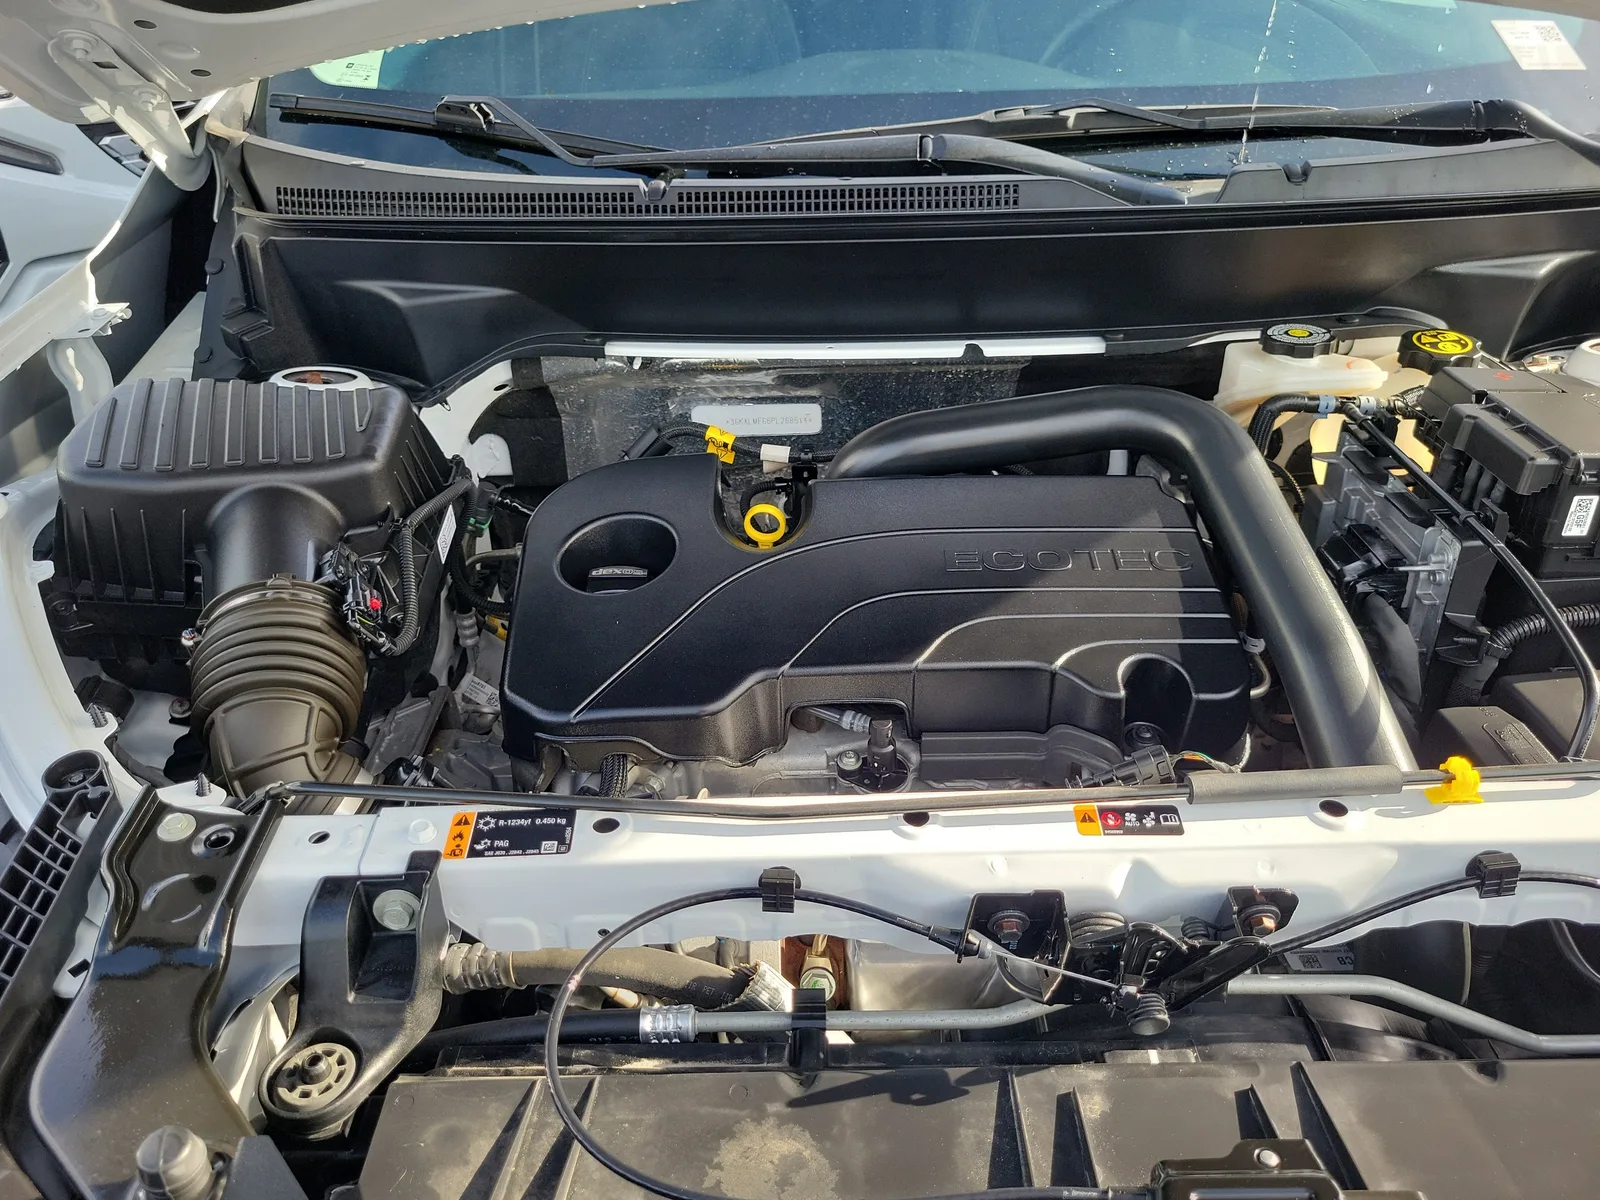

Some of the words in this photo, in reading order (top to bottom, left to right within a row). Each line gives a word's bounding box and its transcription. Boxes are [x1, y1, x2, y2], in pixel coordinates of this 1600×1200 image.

[944, 549, 1194, 572] ECOTEC
[498, 818, 531, 827] R-1234yf
[556, 817, 567, 825] kg
[493, 840, 509, 848] PAG
[1337, 956, 1354, 965] CB
